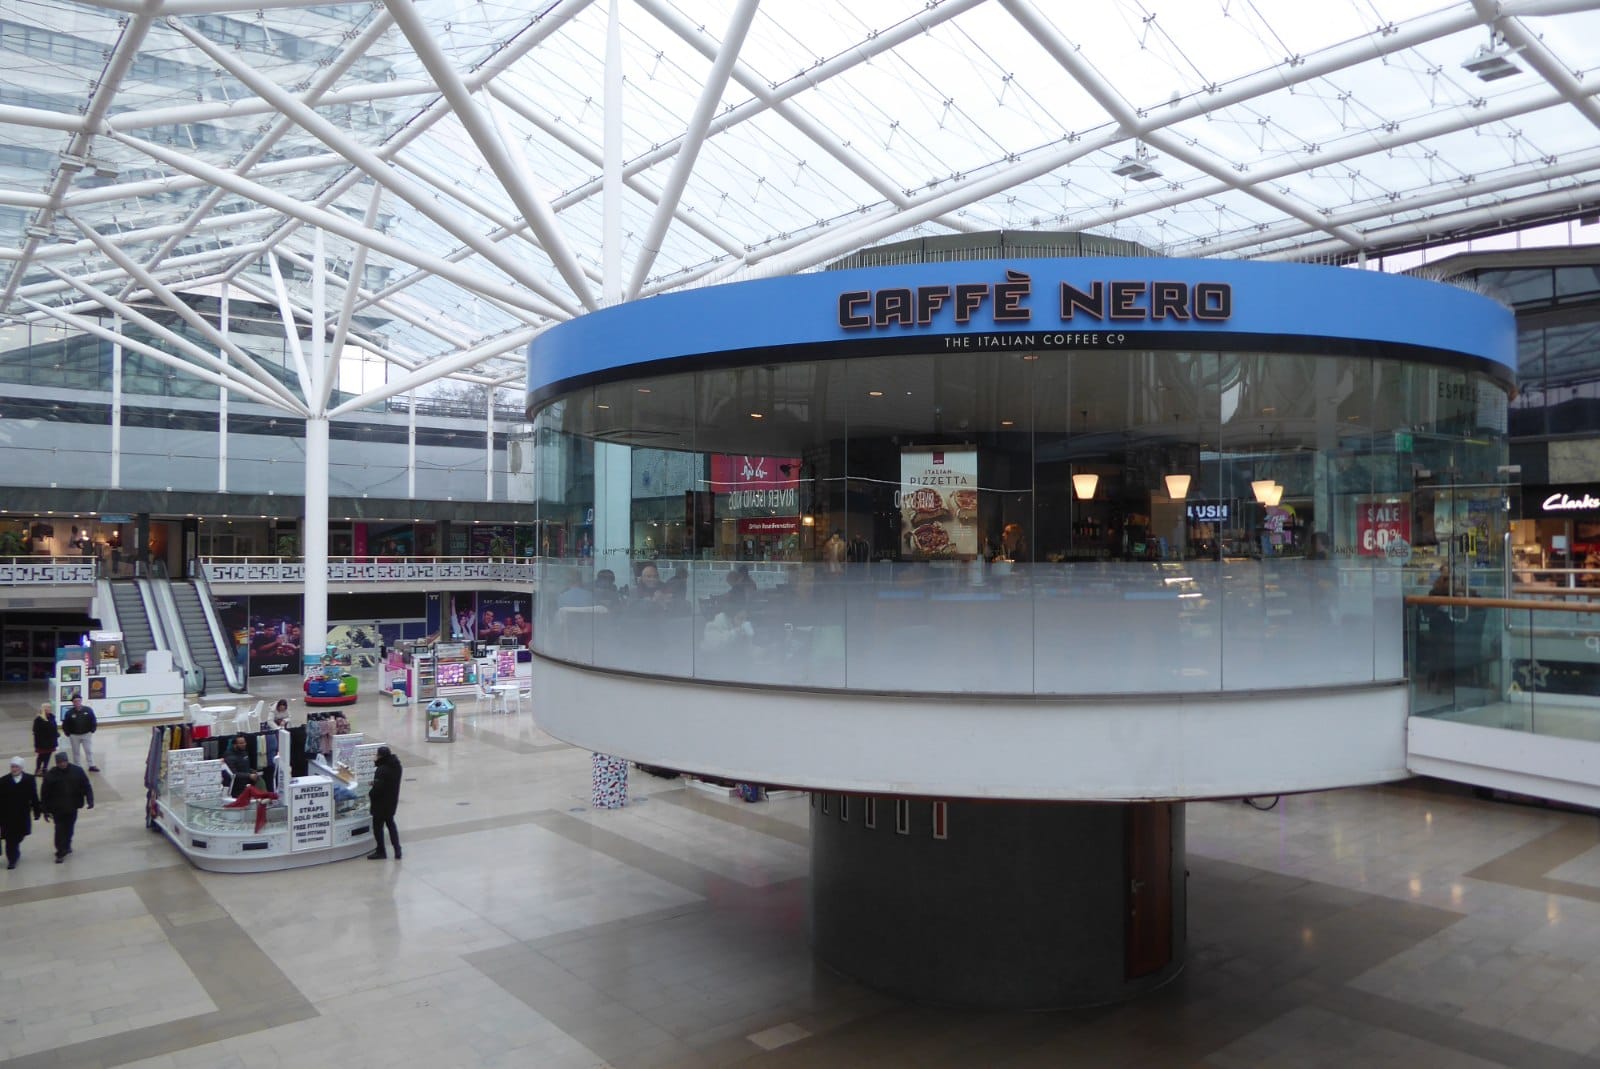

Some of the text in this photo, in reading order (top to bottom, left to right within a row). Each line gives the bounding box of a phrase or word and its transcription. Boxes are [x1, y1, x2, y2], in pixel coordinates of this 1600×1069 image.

[839, 269, 1232, 329] CAFFÈ NERO
[945, 337, 970, 348] THE
[978, 335, 1035, 347] ITALIAN
[1043, 333, 1098, 345] COFFEE
[910, 475, 968, 485] PIZZETTA
[1542, 493, 1600, 511] Clarks
[1187, 505, 1228, 518] LUSH
[1367, 507, 1400, 522] SALE
[294, 791, 329, 800] BATTERIES
[294, 814, 312, 822] SOLD
[307, 821, 330, 829] FITTINGS
